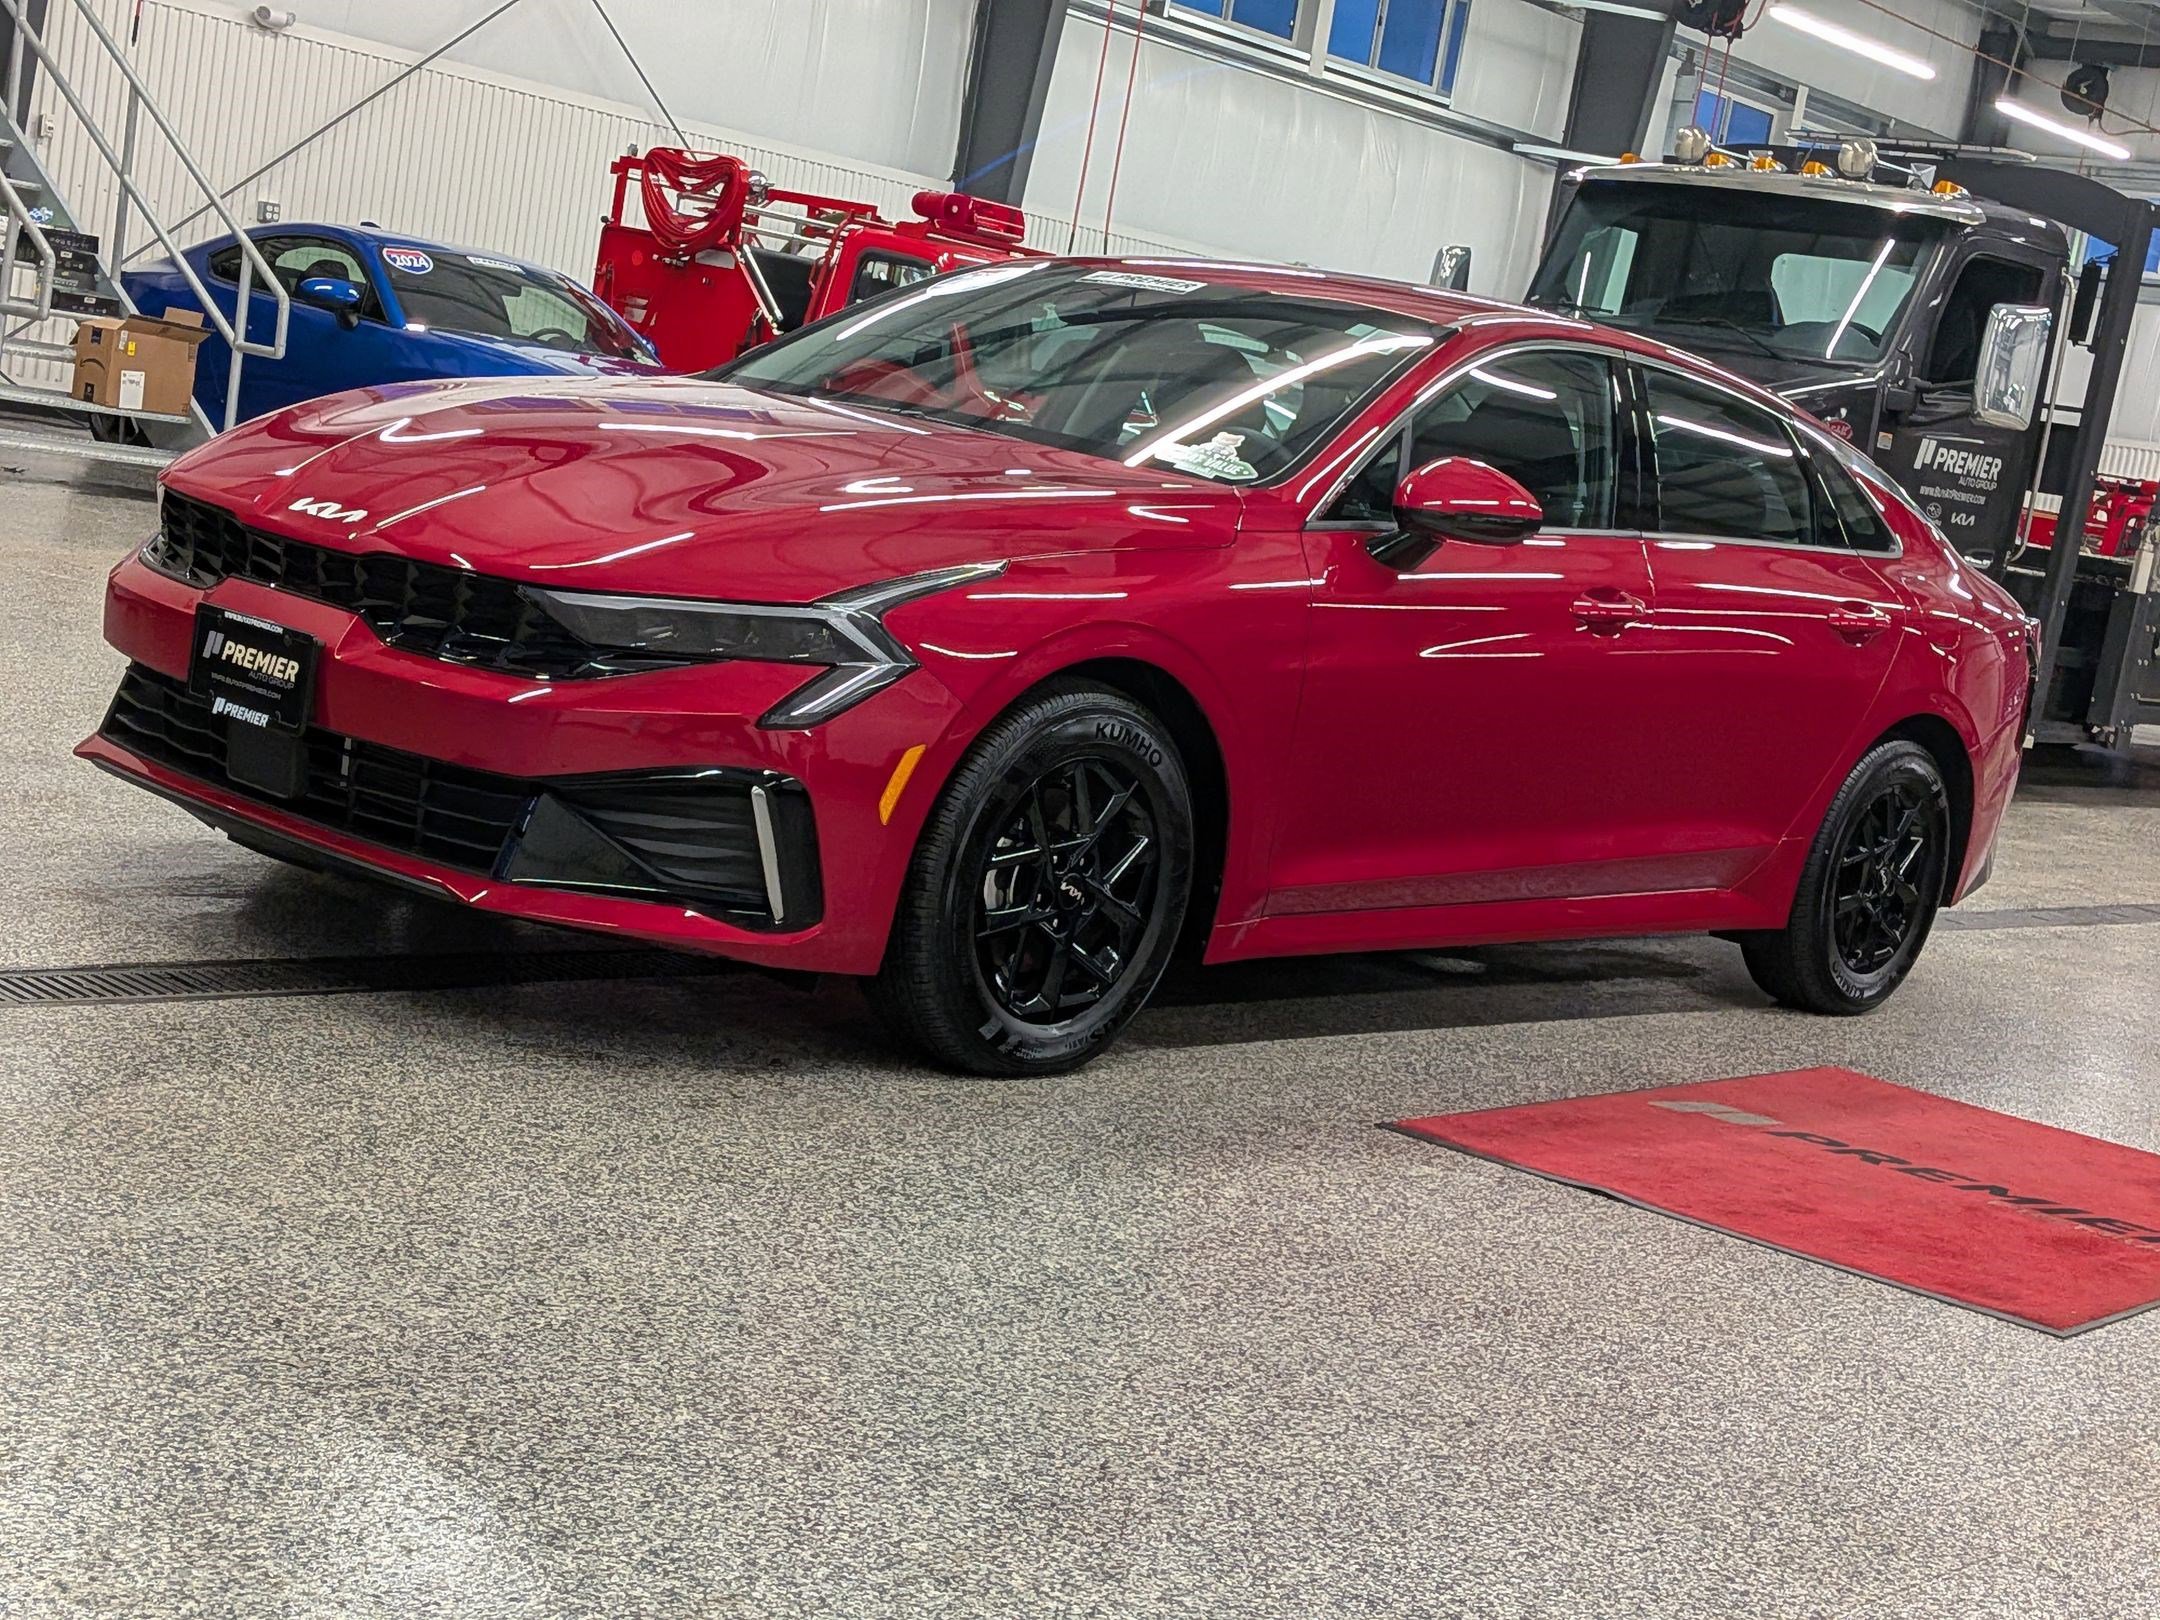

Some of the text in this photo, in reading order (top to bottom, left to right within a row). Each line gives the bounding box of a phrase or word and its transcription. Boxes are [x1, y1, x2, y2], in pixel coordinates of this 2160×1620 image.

[390, 253, 429, 269] 2024
[1203, 457, 1244, 475] VALUE
[1933, 447, 2002, 481] PREMIER
[1958, 476, 1998, 491] AUTO GROUP
[288, 497, 368, 523] KIA
[221, 640, 299, 683] PREMIER
[248, 671, 295, 690] AUTO GROUP
[223, 702, 269, 728] PREMIER
[1095, 722, 1162, 768] KUMHO
